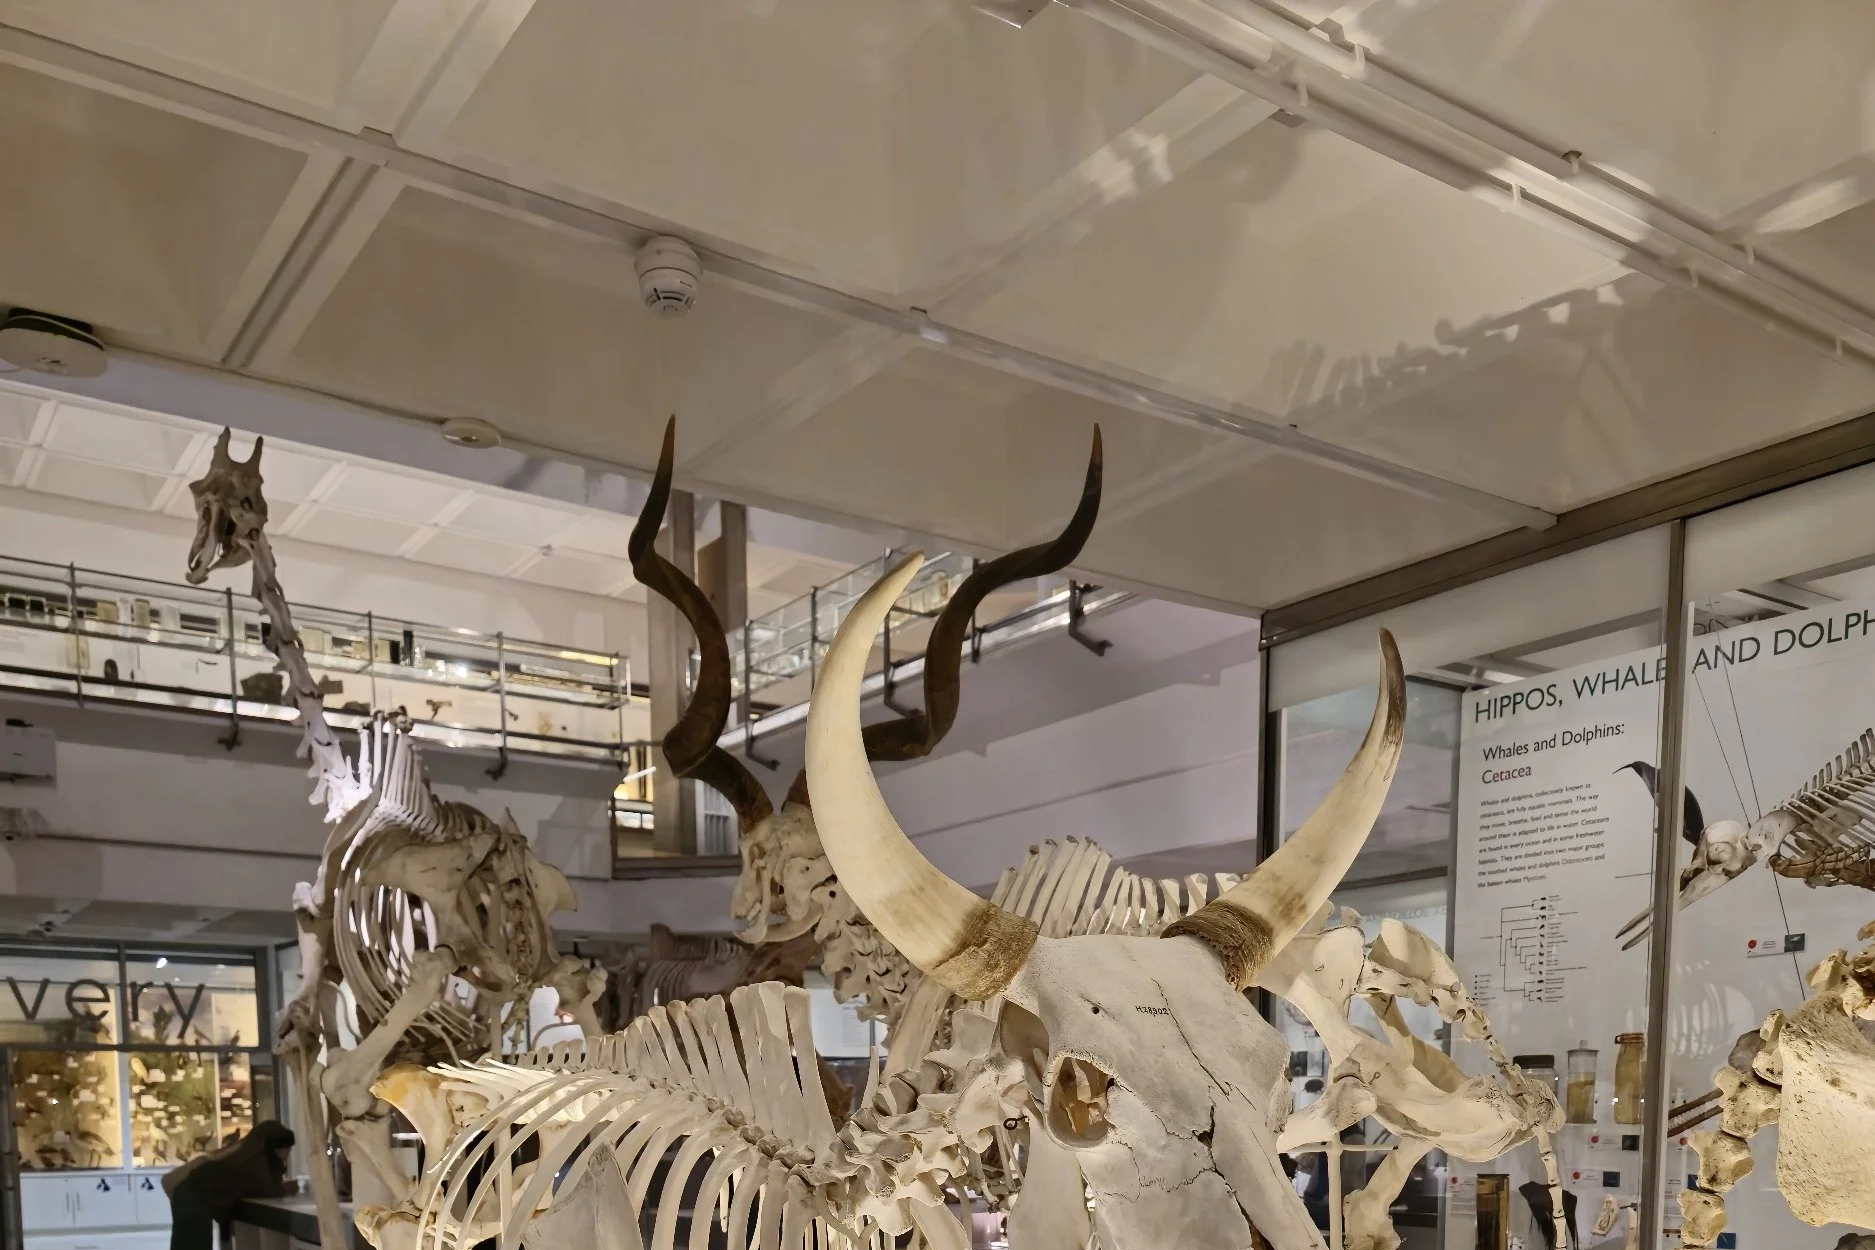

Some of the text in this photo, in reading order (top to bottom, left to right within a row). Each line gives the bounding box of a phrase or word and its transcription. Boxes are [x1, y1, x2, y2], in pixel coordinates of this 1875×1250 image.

[1475, 683, 1563, 723] HIPPOS,
[1572, 656, 1666, 700] WHALE
[1691, 636, 1761, 674] AND
[1483, 723, 1625, 761] Whales and Dolphins:
[1482, 766, 1532, 784] Cetacea
[1581, 805, 1598, 813] world
[6, 976, 206, 1040] very
